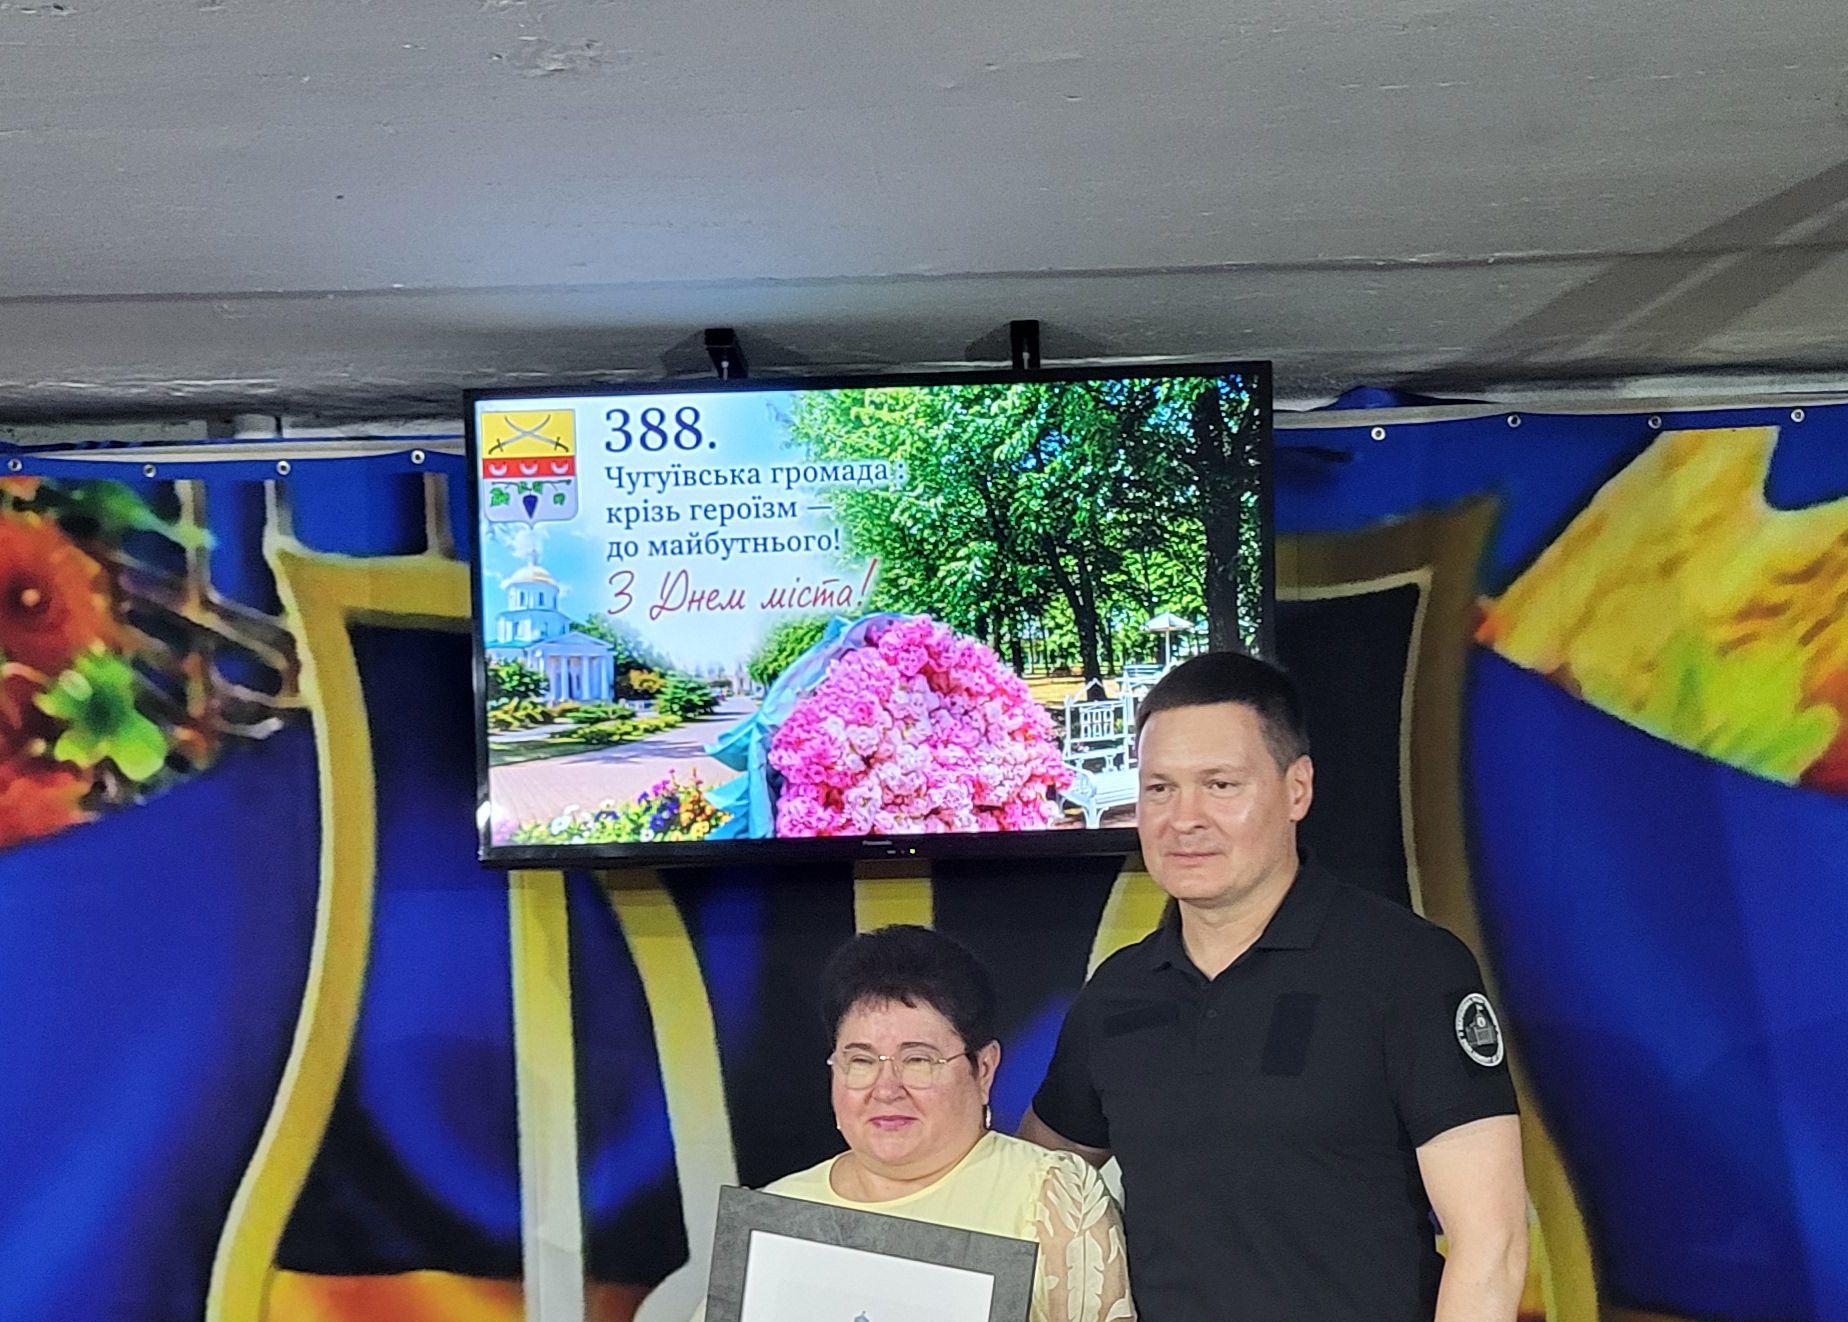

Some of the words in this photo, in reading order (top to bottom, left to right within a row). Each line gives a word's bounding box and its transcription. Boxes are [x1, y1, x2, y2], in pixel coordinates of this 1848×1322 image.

[605, 406, 716, 452] 388.
[605, 463, 761, 495] Чугуївська
[771, 465, 888, 490] громада
[607, 499, 680, 529] крізь
[690, 495, 797, 526] героїзм
[607, 540, 638, 561] до
[648, 529, 840, 560] майбутнього!
[649, 569, 746, 620] Днем
[761, 558, 877, 610] міста!
